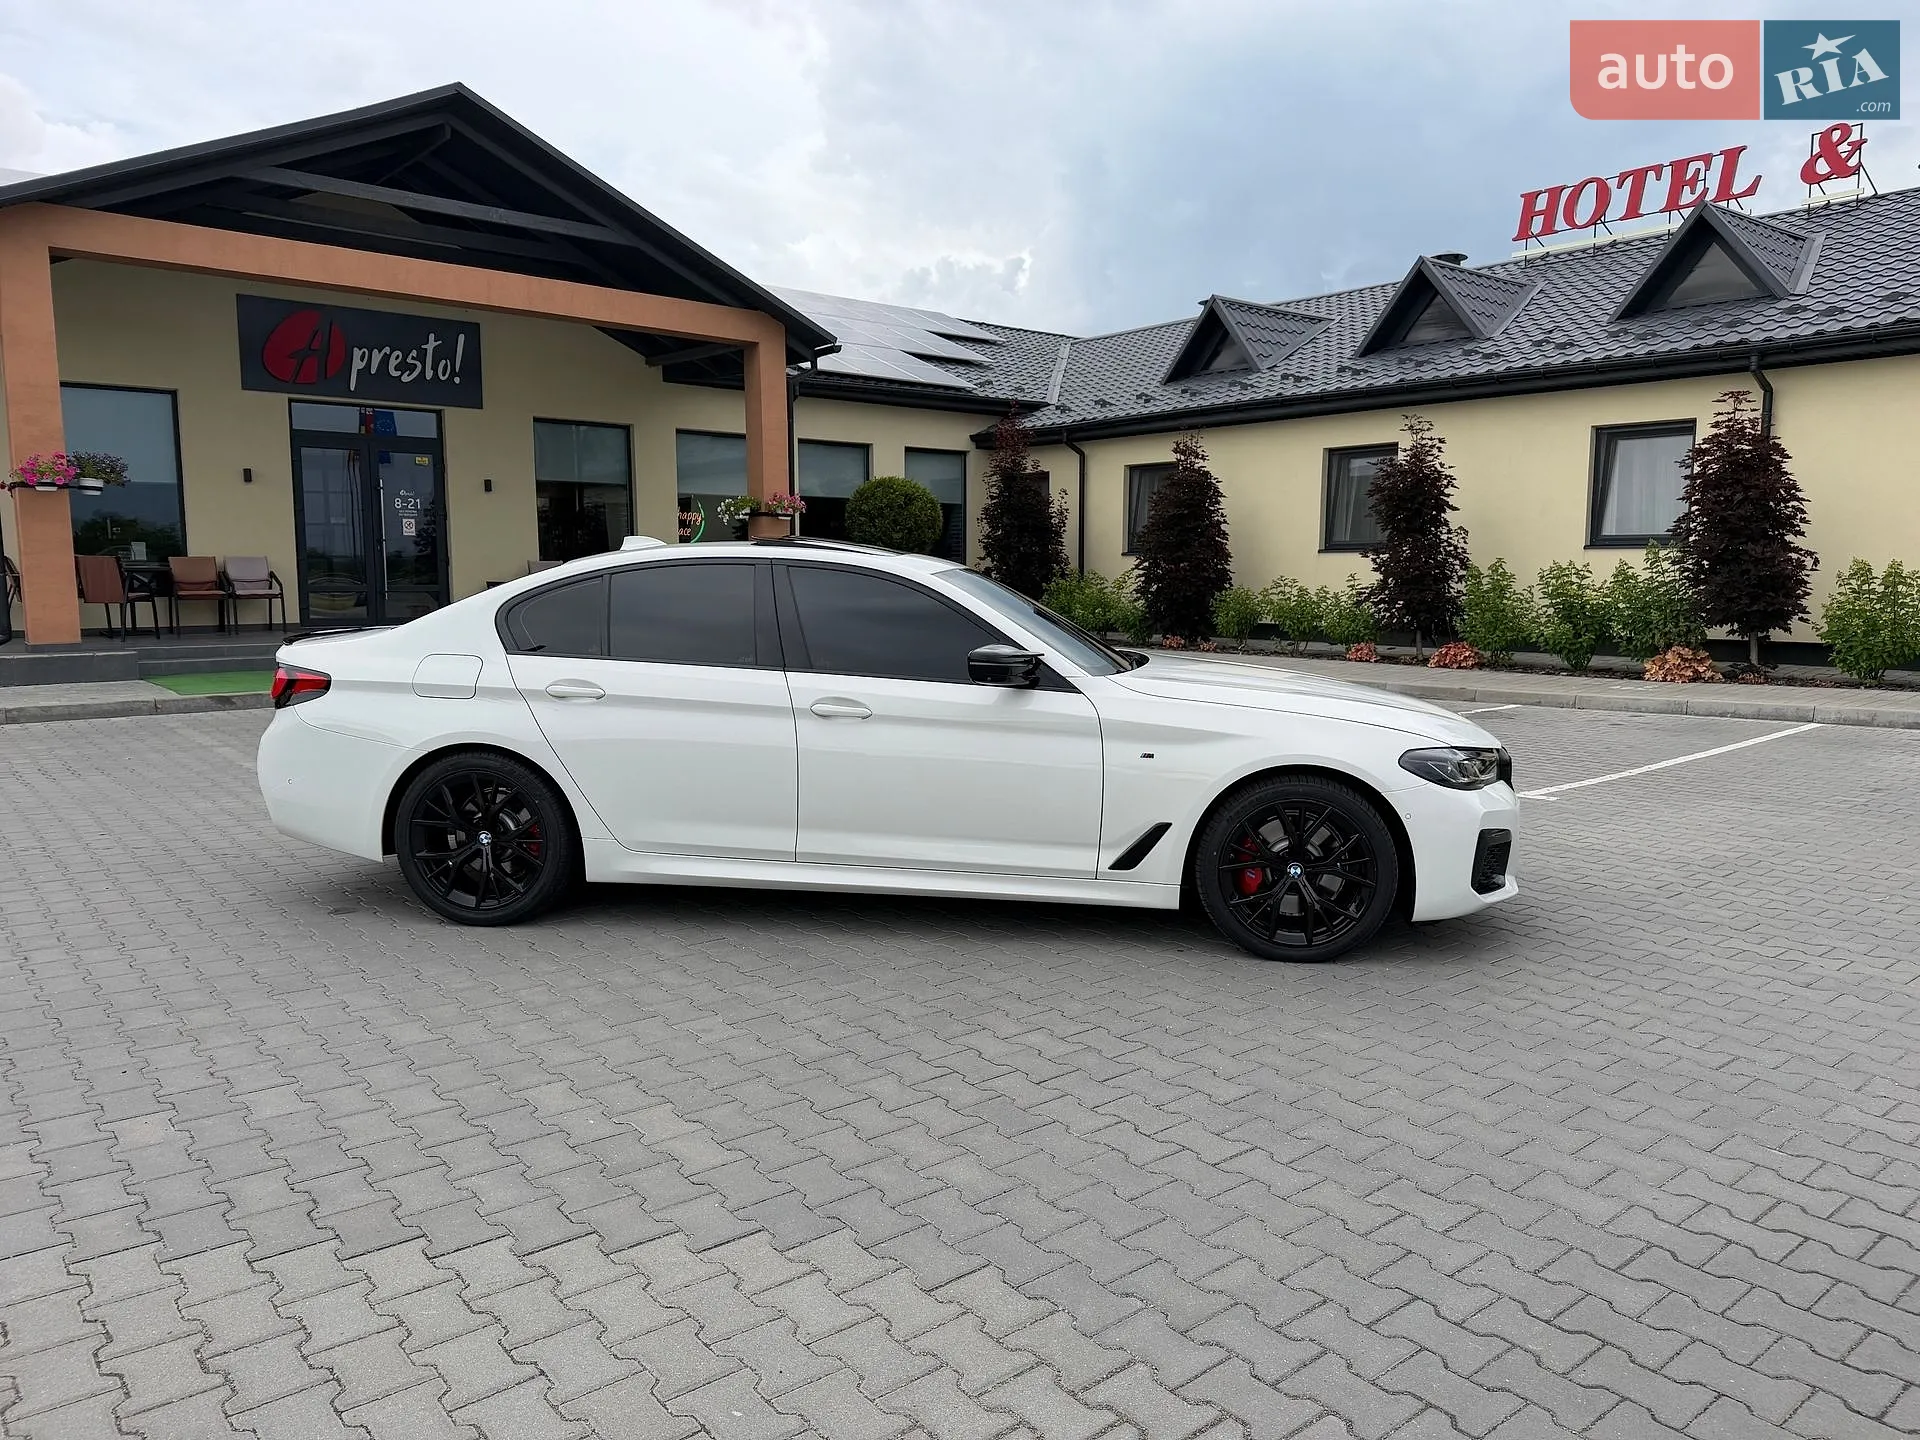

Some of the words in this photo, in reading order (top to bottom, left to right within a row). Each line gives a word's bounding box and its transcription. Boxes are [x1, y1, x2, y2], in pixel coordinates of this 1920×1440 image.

[1511, 145, 1763, 241] HOTEL
[1799, 122, 1868, 185] &
[350, 332, 465, 392] presto!
[394, 497, 420, 509] 8-21
